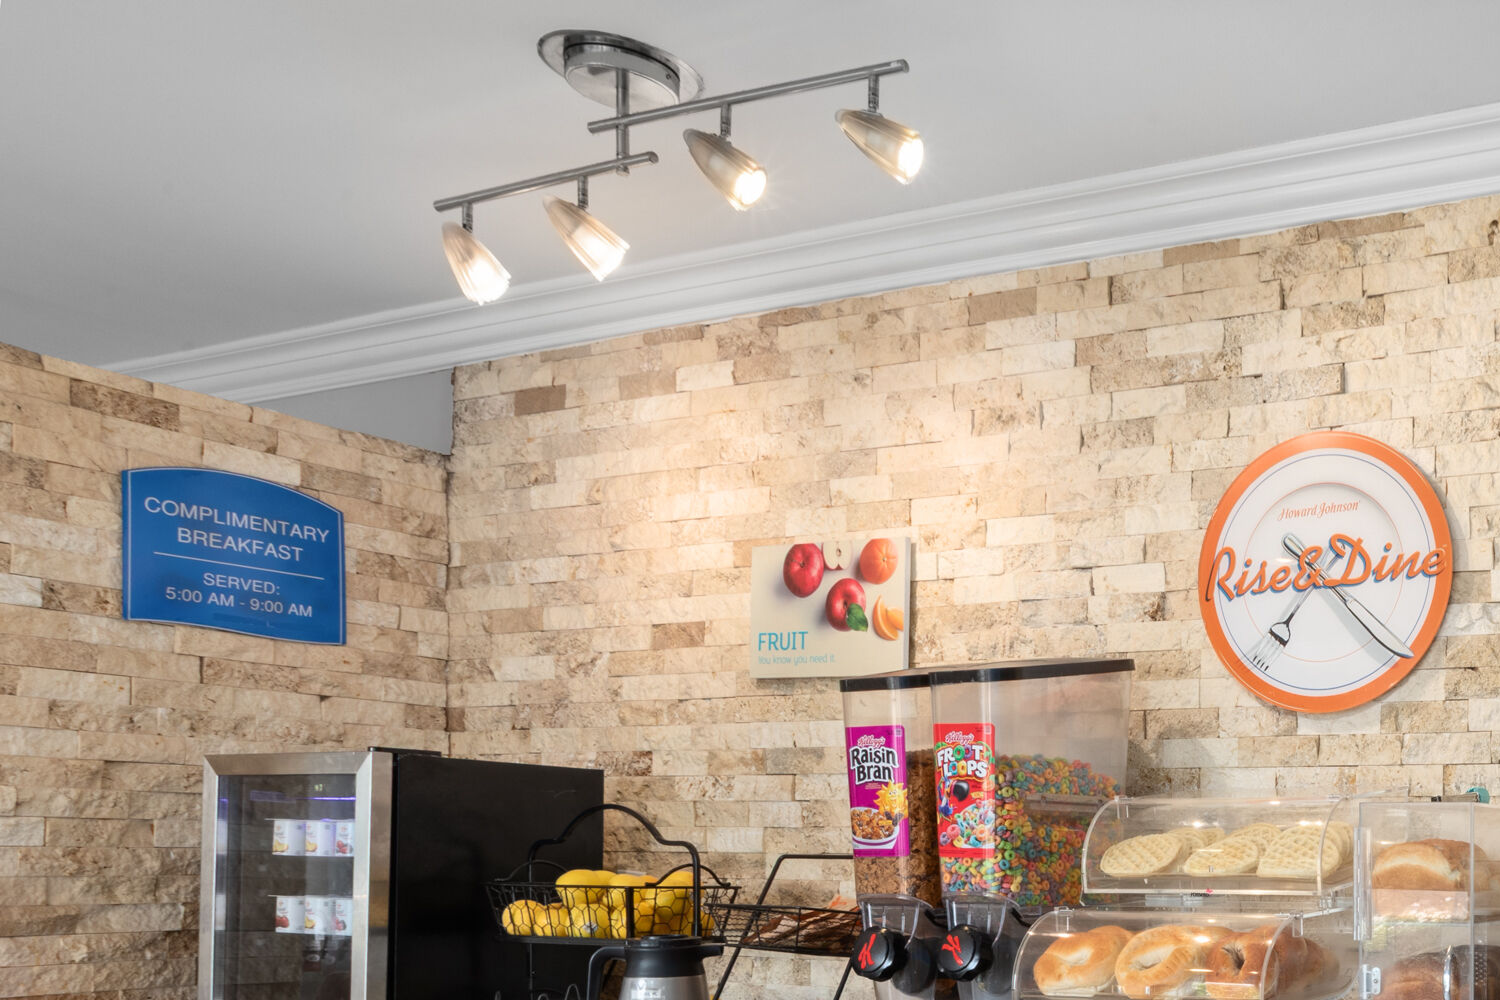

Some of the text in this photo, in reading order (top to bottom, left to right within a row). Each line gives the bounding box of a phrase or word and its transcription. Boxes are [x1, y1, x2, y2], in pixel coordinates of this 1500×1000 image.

[143, 496, 330, 543] COMPLIMENTARY
[1277, 501, 1359, 522] Howard Johnson
[176, 526, 304, 562] BREAKFAST
[203, 572, 281, 596] SERVED:
[165, 586, 203, 603] 5:00
[207, 591, 235, 608] AM
[249, 598, 284, 614] 9:00
[287, 603, 313, 618] AM
[758, 630, 808, 652] FRUIT
[810, 653, 828, 664] need
[850, 747, 898, 769] Raisin
[937, 744, 984, 767] FROOT
[856, 764, 894, 784] Bran
[943, 760, 988, 778] LOOPS
